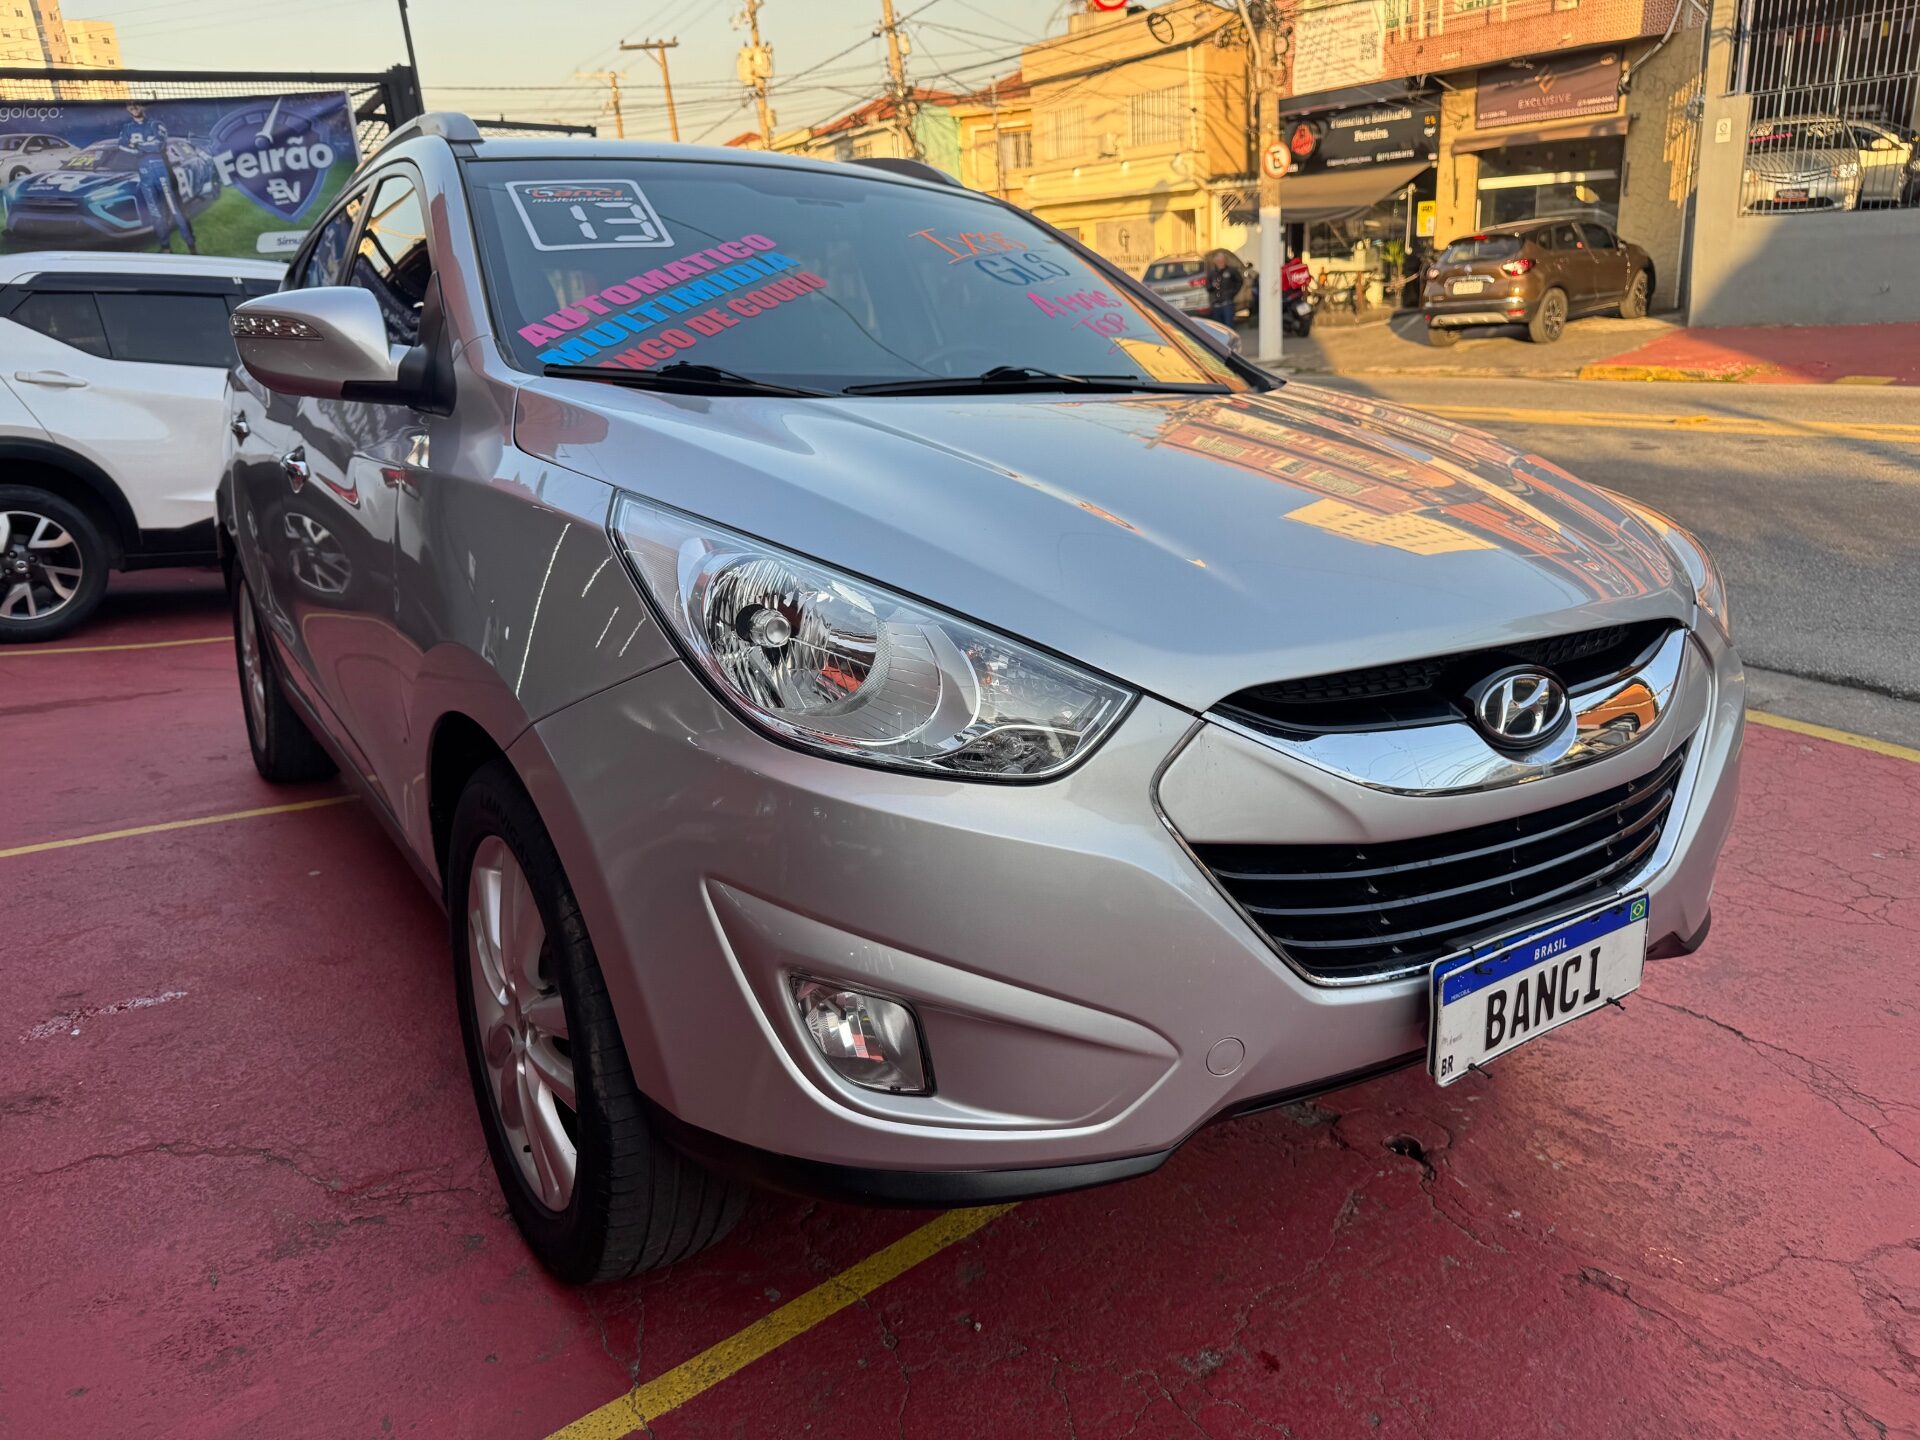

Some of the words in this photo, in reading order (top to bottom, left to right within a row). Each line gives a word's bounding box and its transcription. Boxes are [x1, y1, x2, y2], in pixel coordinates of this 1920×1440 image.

[0, 104, 65, 122] golaço:
[213, 136, 334, 186] Feirão
[569, 202, 659, 242] 13
[517, 233, 777, 348] AUTOMATICO
[536, 251, 801, 366] MULTIMIDIA
[684, 307, 741, 337] DE
[726, 271, 828, 318] COURO
[1534, 937, 1568, 960] BRASIL
[1484, 945, 1601, 1051] BANCI
[1441, 1054, 1454, 1077] BR
